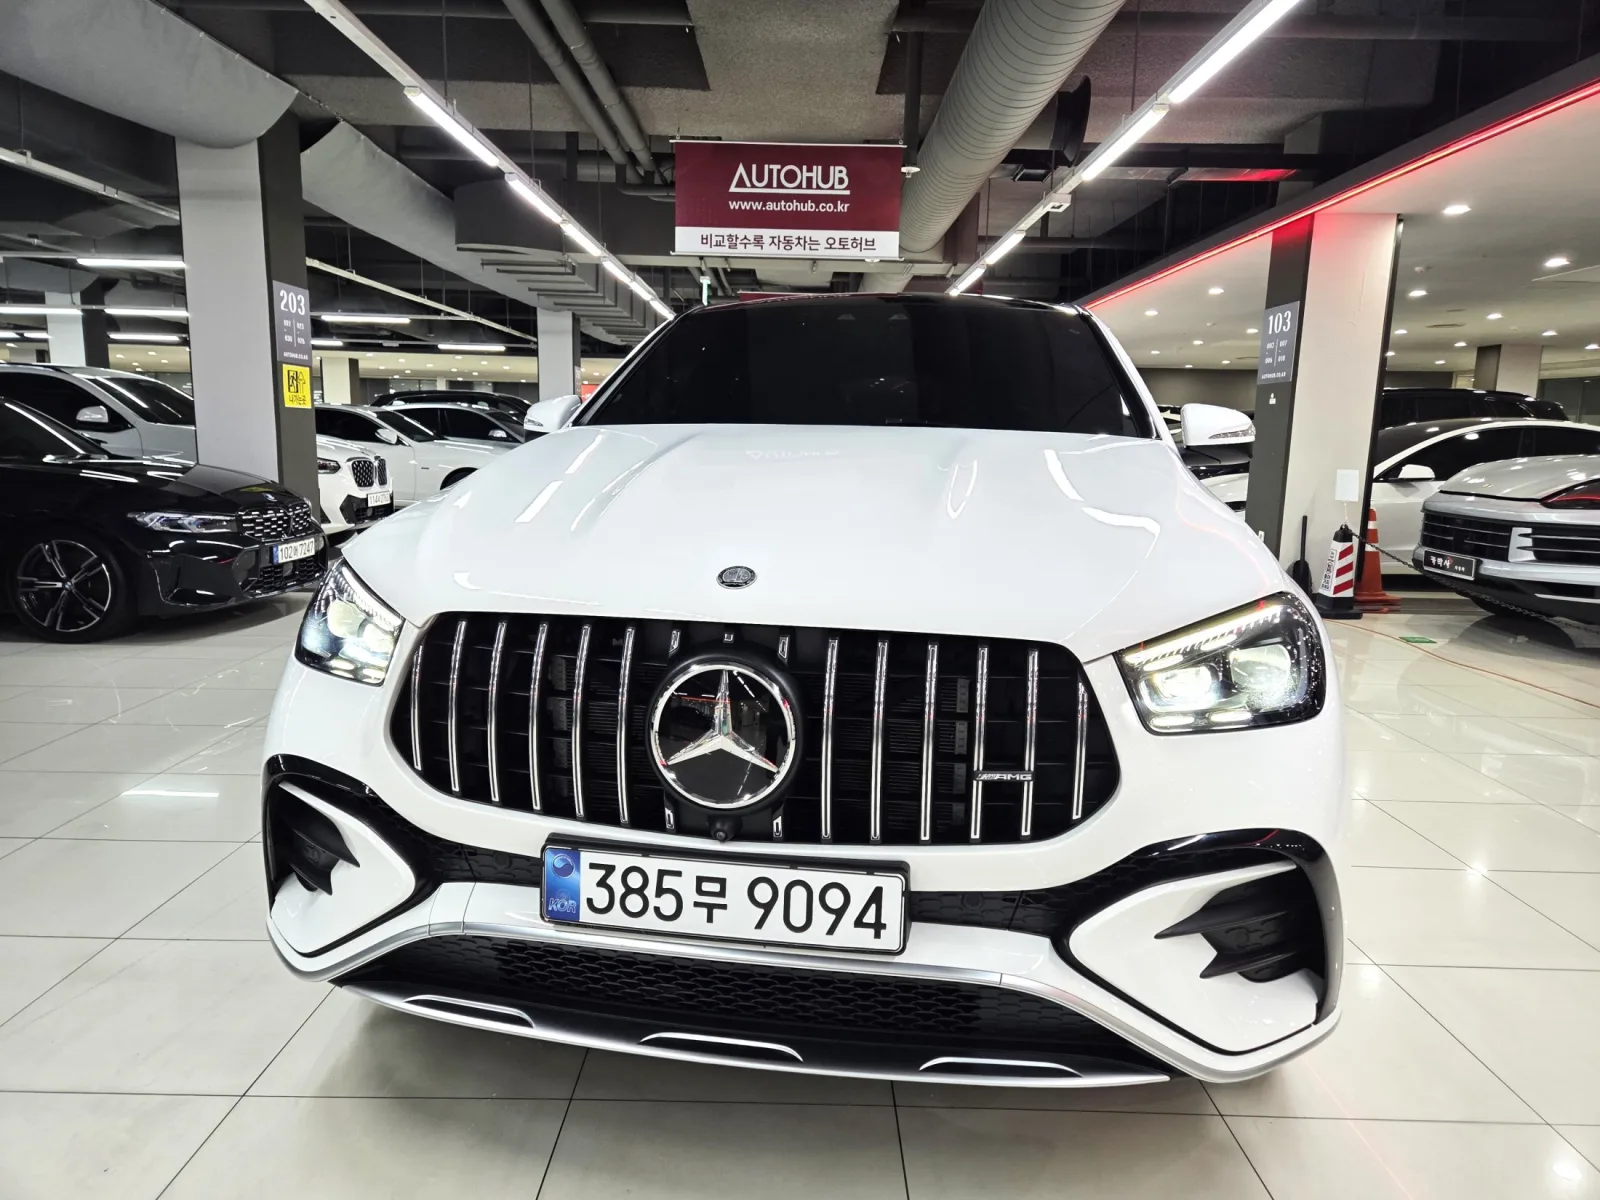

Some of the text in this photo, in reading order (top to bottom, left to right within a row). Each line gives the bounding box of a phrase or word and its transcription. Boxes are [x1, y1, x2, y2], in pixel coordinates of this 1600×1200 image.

[728, 162, 850, 195] AUTOHUB
[728, 199, 850, 213] www.autohub.co.kr
[701, 233, 876, 252] 비교할수록 자동차는 오토허브
[280, 289, 305, 316] 203
[1268, 310, 1292, 335] 103
[299, 540, 314, 557] 7247
[994, 773, 1032, 781] AMG
[547, 897, 577, 914] KOR
[586, 862, 887, 939] 385무 9094
